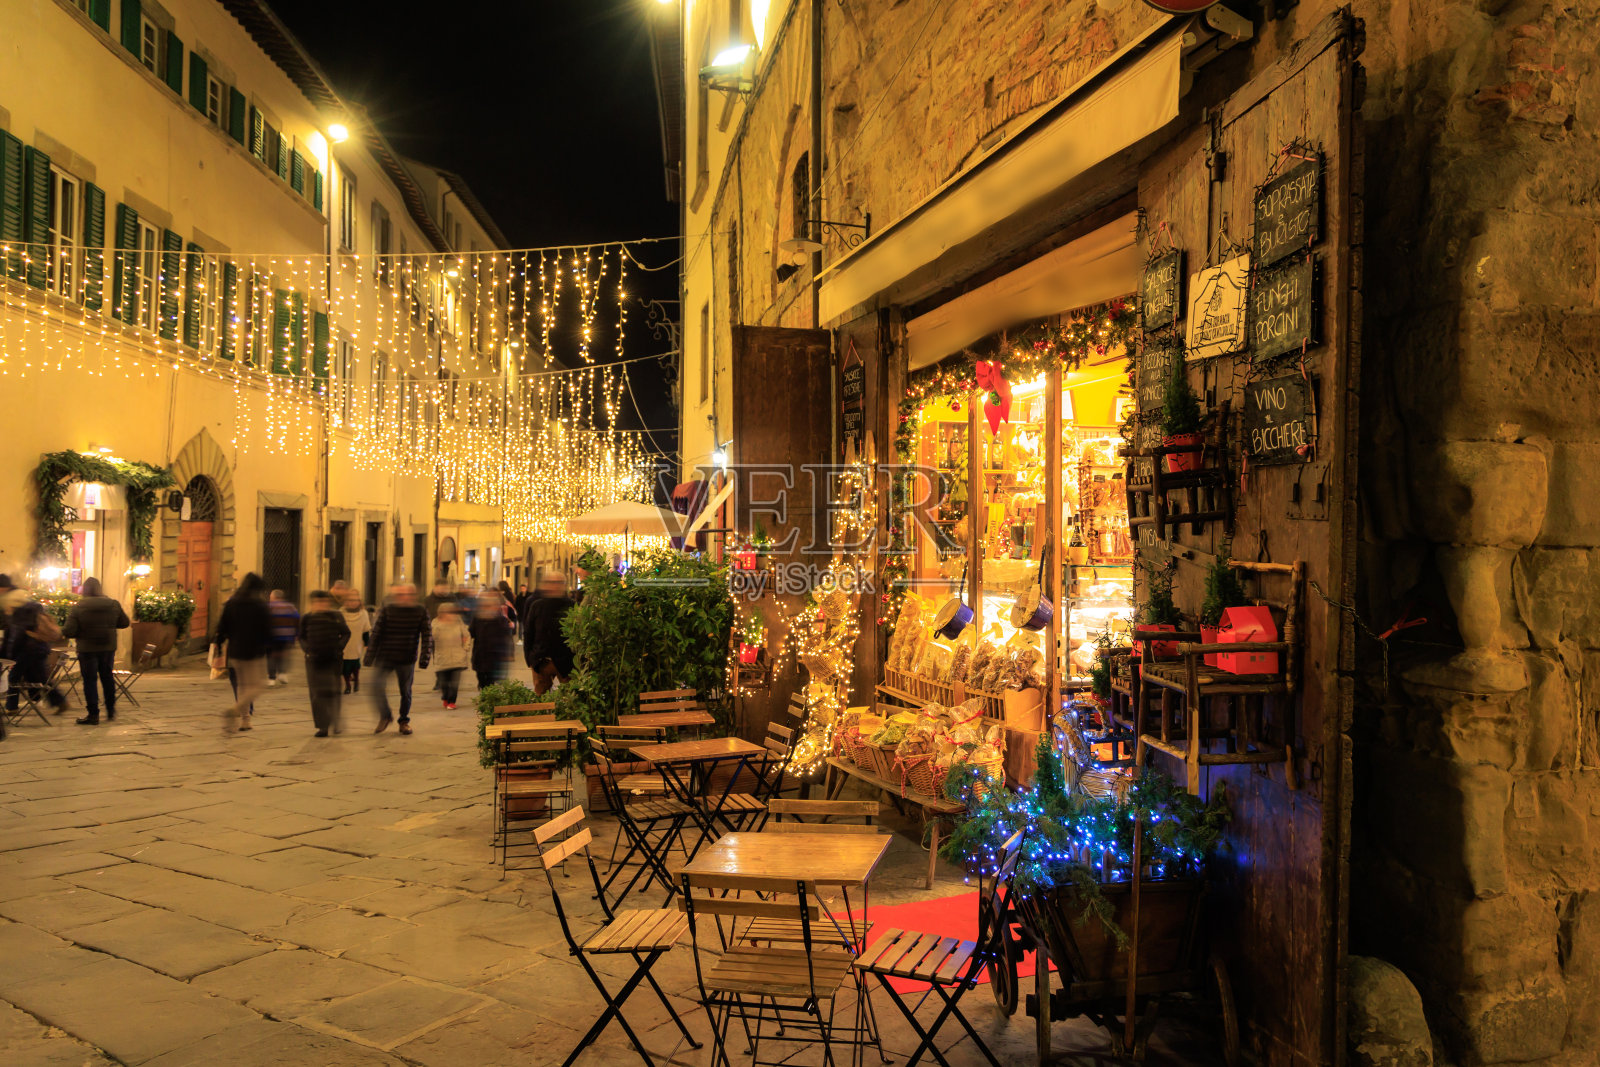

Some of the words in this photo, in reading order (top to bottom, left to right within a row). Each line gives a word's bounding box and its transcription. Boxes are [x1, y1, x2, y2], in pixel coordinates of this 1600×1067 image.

[1258, 169, 1316, 220] SOPRASSATA
[1255, 278, 1298, 315] FUNGHI
[1255, 306, 1299, 345] PORCINI
[1254, 386, 1287, 411] VINO
[1251, 419, 1307, 455] BICCHIERE
